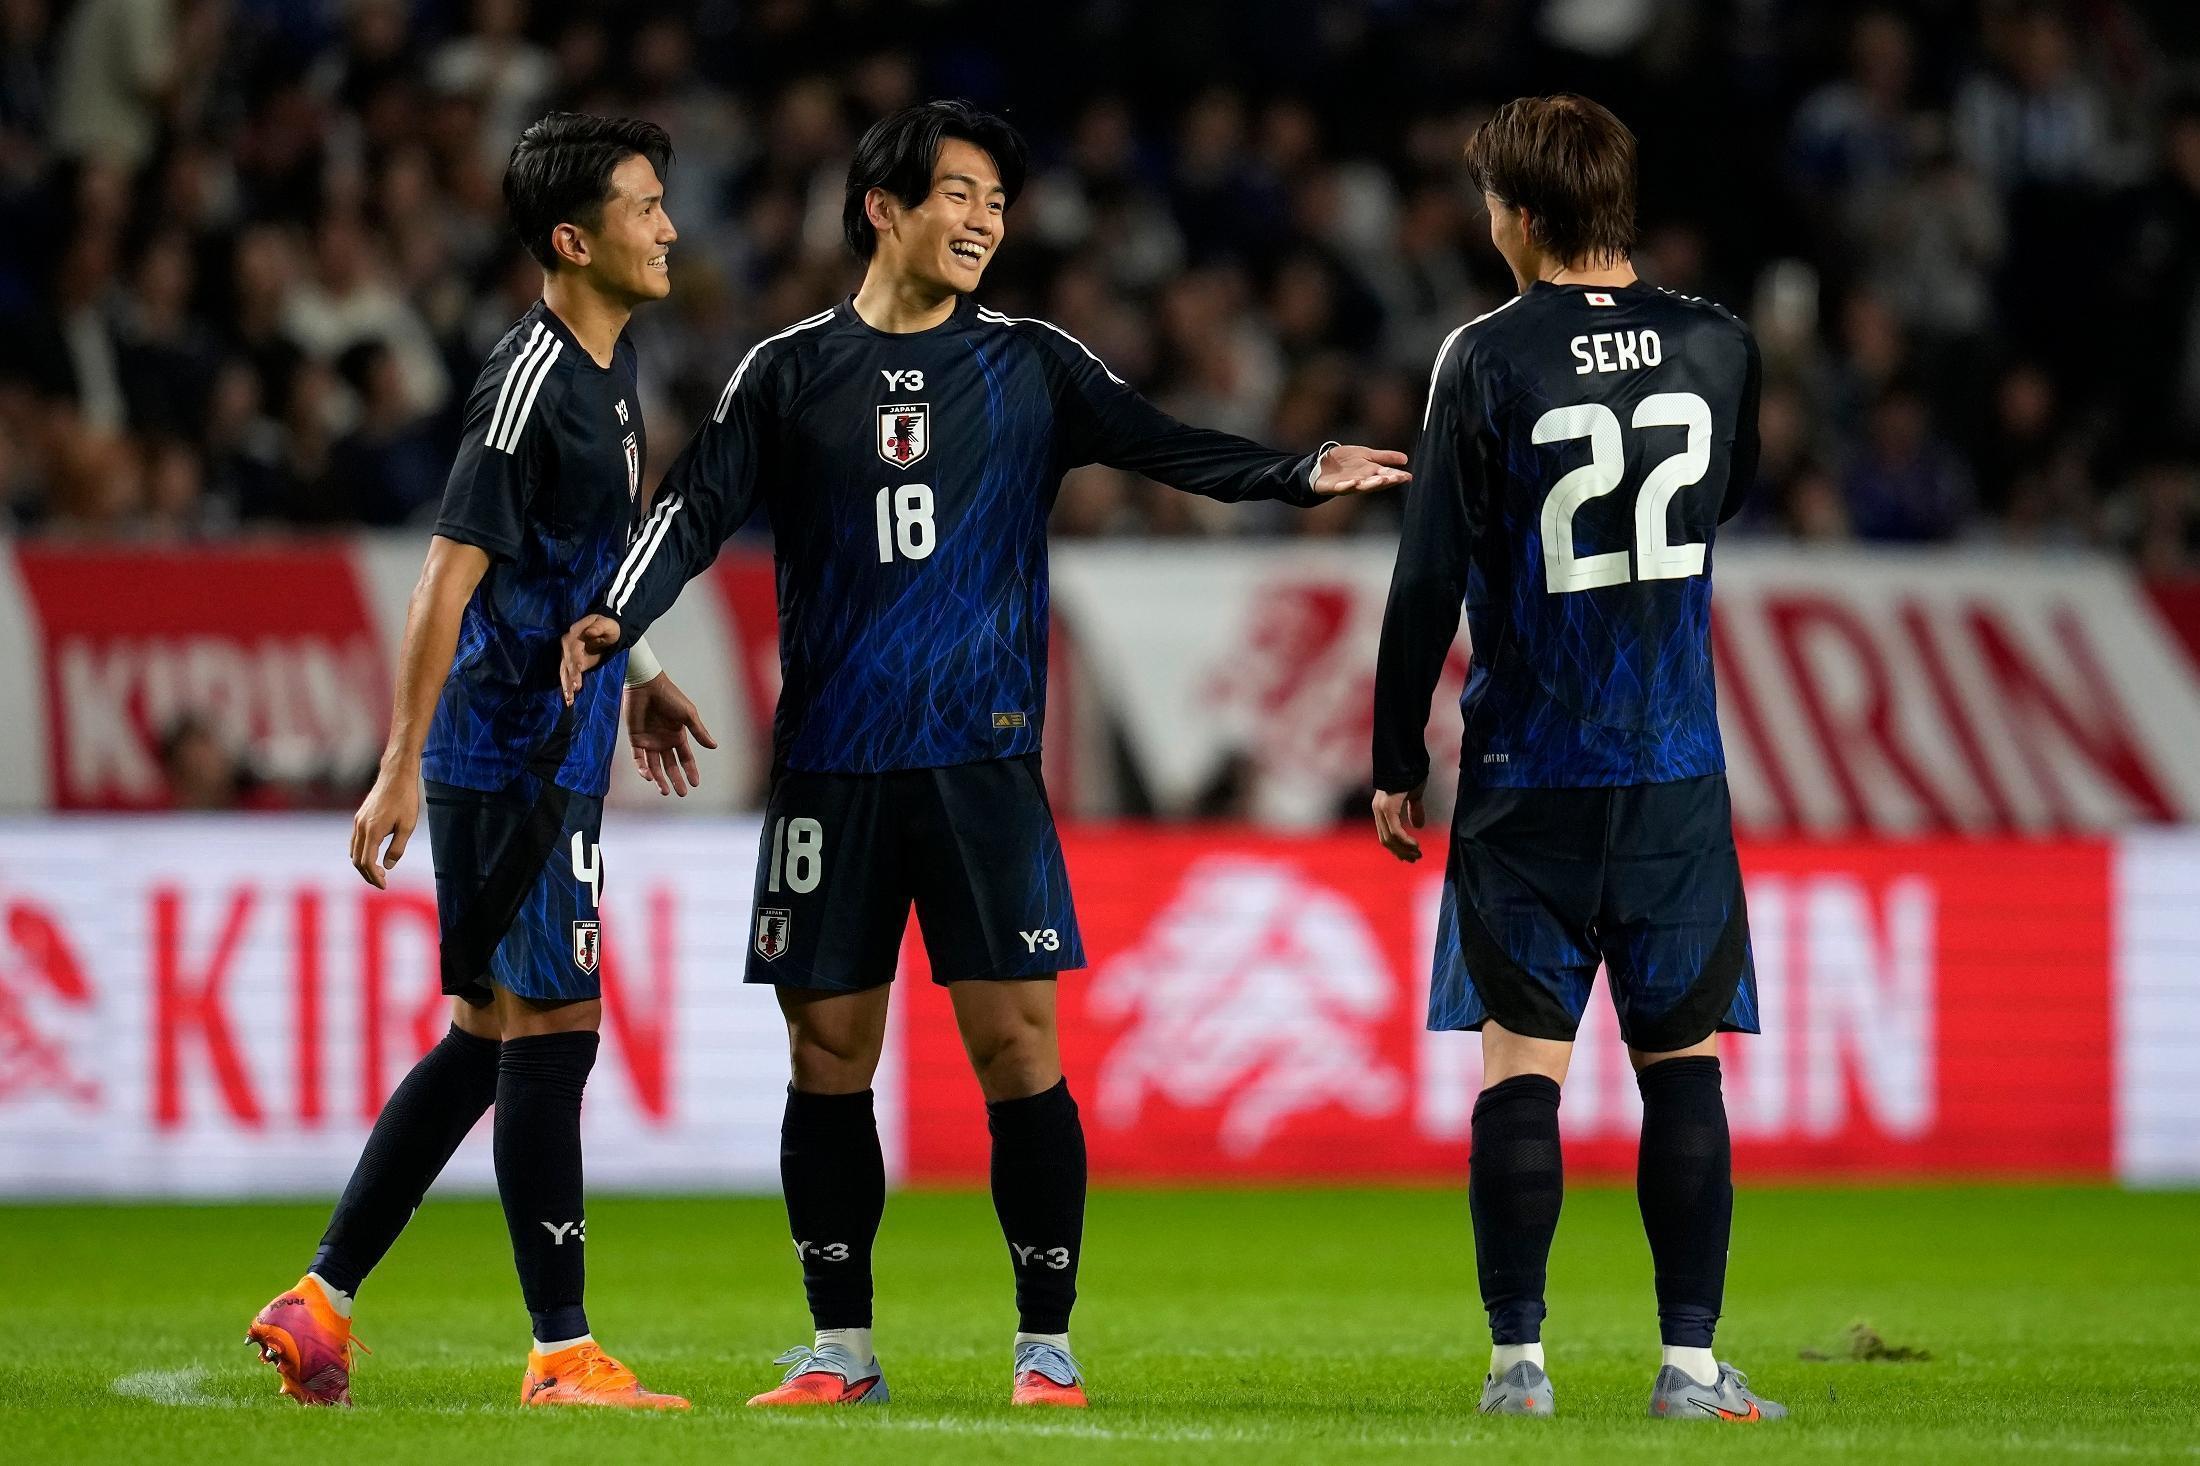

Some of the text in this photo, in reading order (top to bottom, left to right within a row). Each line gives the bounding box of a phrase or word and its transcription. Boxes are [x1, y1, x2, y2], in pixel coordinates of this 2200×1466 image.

[881, 369, 924, 392] Y-3
[1570, 329, 1662, 375] SEKO
[876, 483, 936, 563] 18
[1531, 392, 1712, 594] 22
[1706, 588, 2182, 836] IRIN
[571, 830, 600, 908] 4
[768, 816, 823, 894] 18
[1019, 928, 1060, 953] Y-3
[148, 876, 682, 1134] KIRN
[792, 1238, 850, 1262] Y-3
[1012, 1242, 1070, 1270] Y-3
